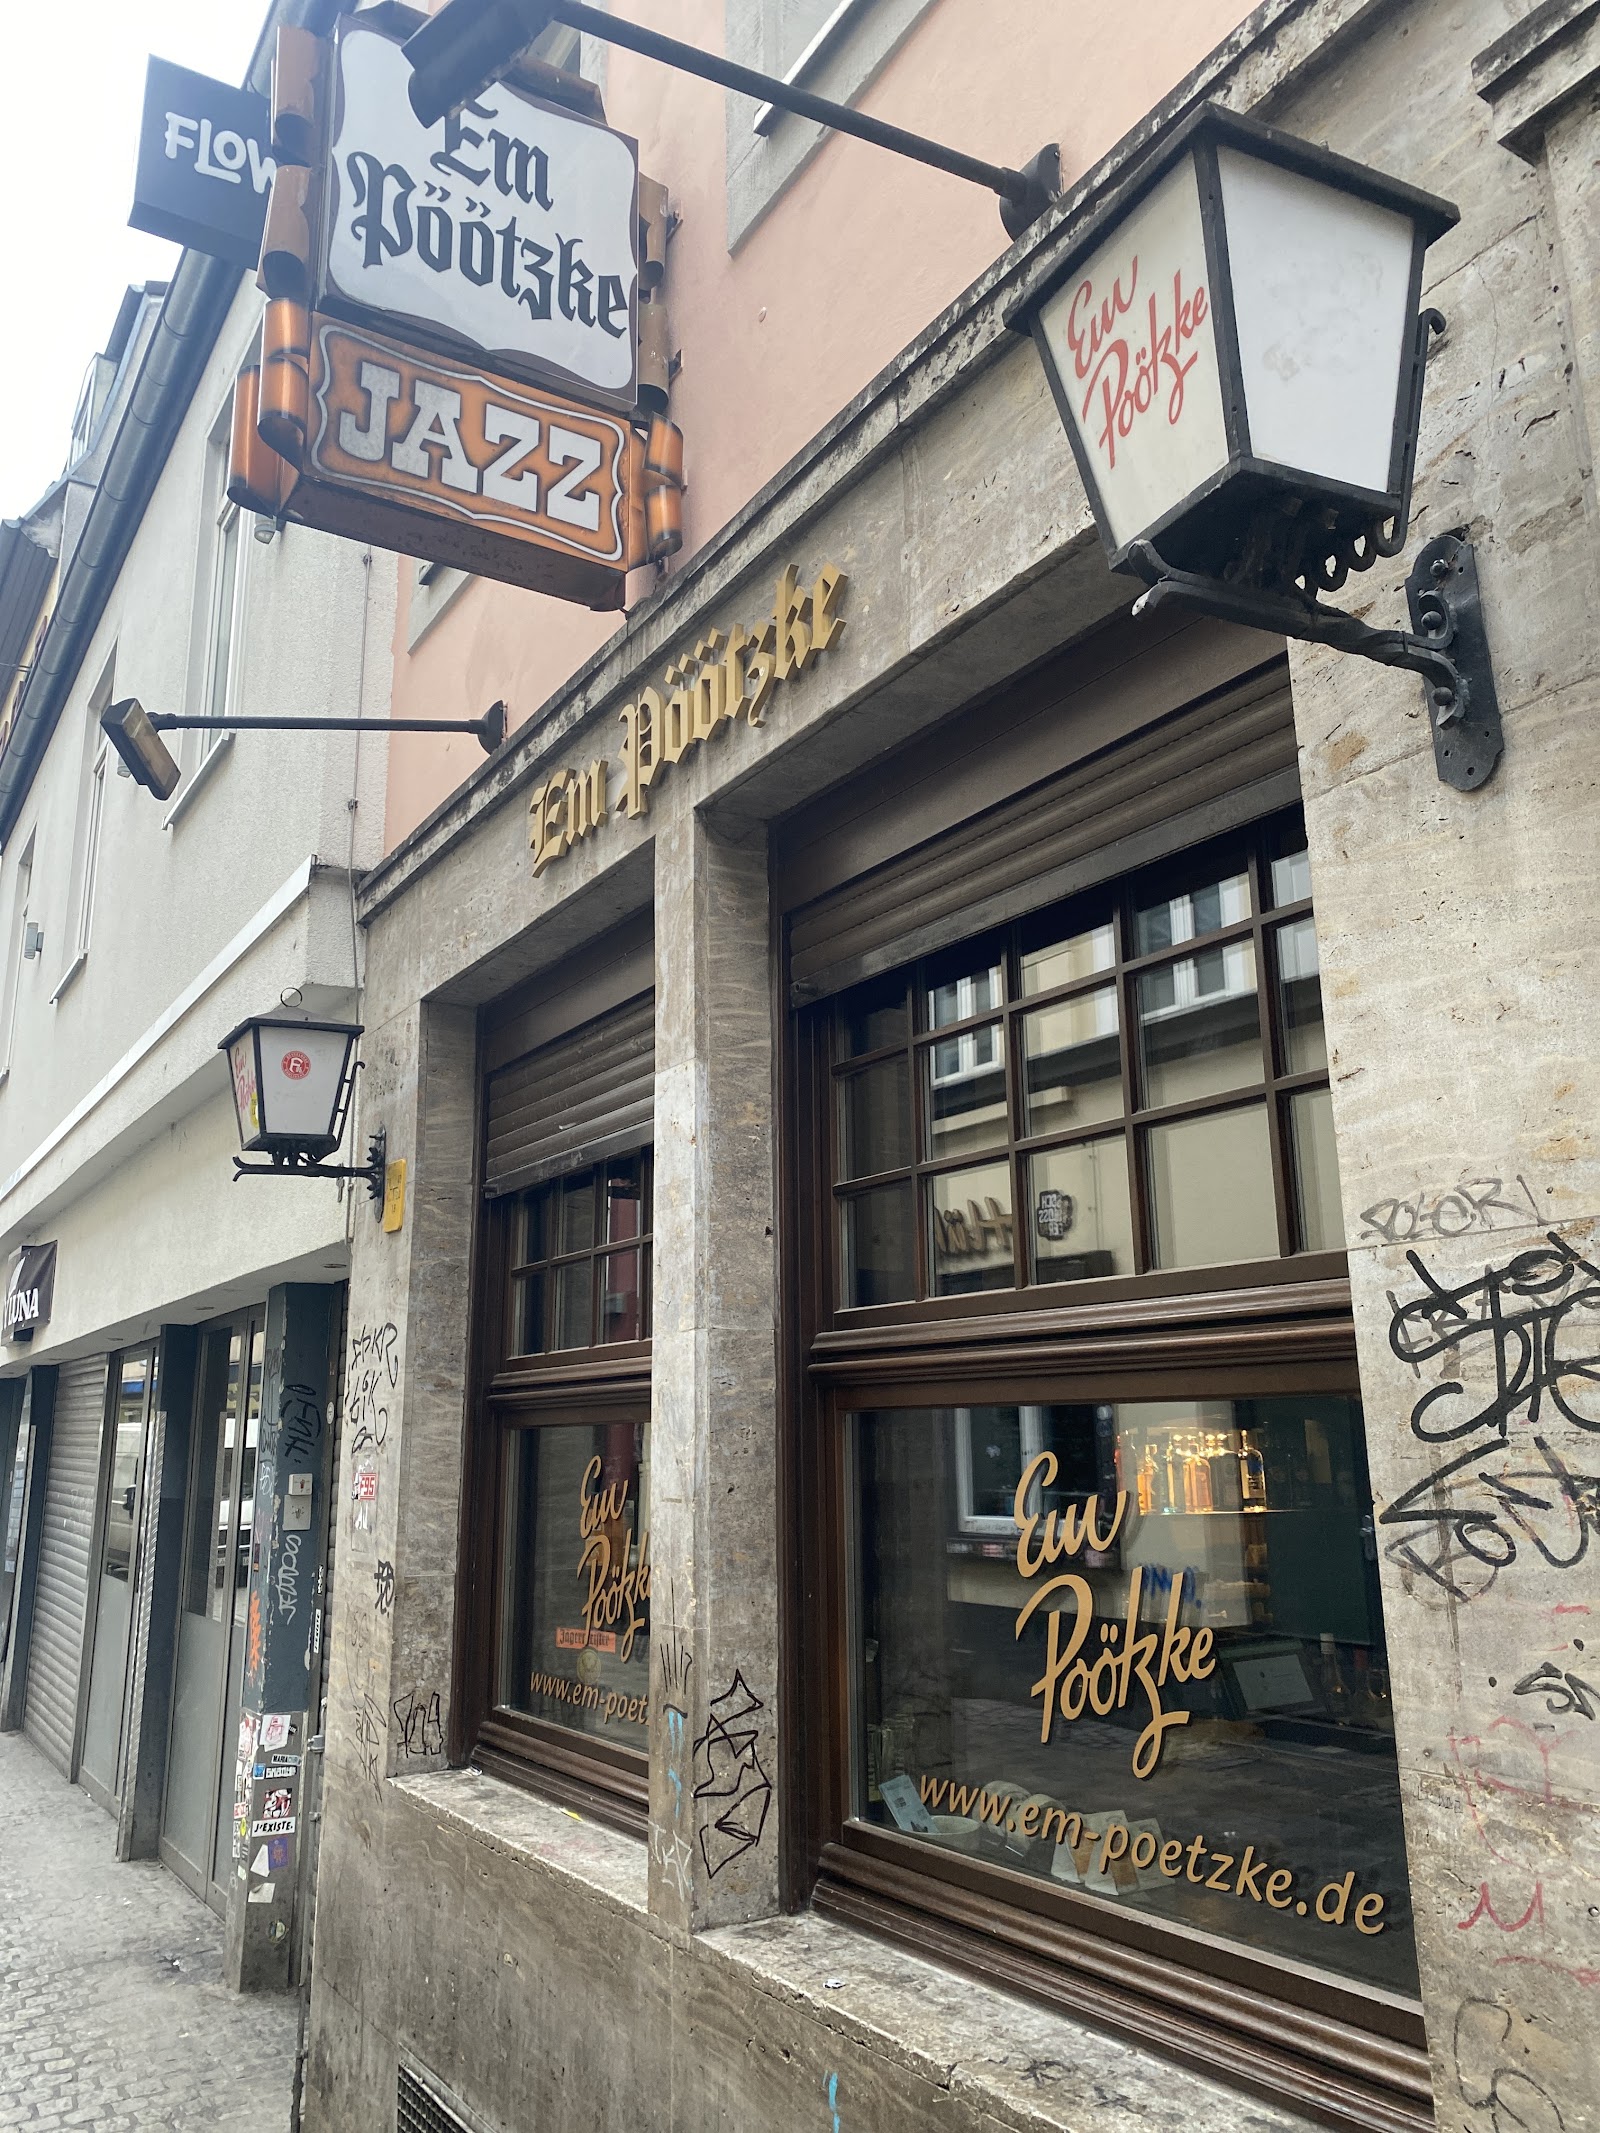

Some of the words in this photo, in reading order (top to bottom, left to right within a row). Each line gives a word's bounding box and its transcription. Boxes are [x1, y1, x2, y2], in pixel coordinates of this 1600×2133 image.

[429, 100, 554, 212] Em
[346, 151, 630, 339] Pöötzke
[338, 358, 601, 532] JAZZ
[529, 758, 608, 878] Em
[615, 561, 848, 821] Pöötzke
[530, 1671, 650, 1726] www.em-poet
[253, 1821, 293, 1833] J'EXISTE.
[919, 1773, 1385, 1935] www.em-poetzke.de
